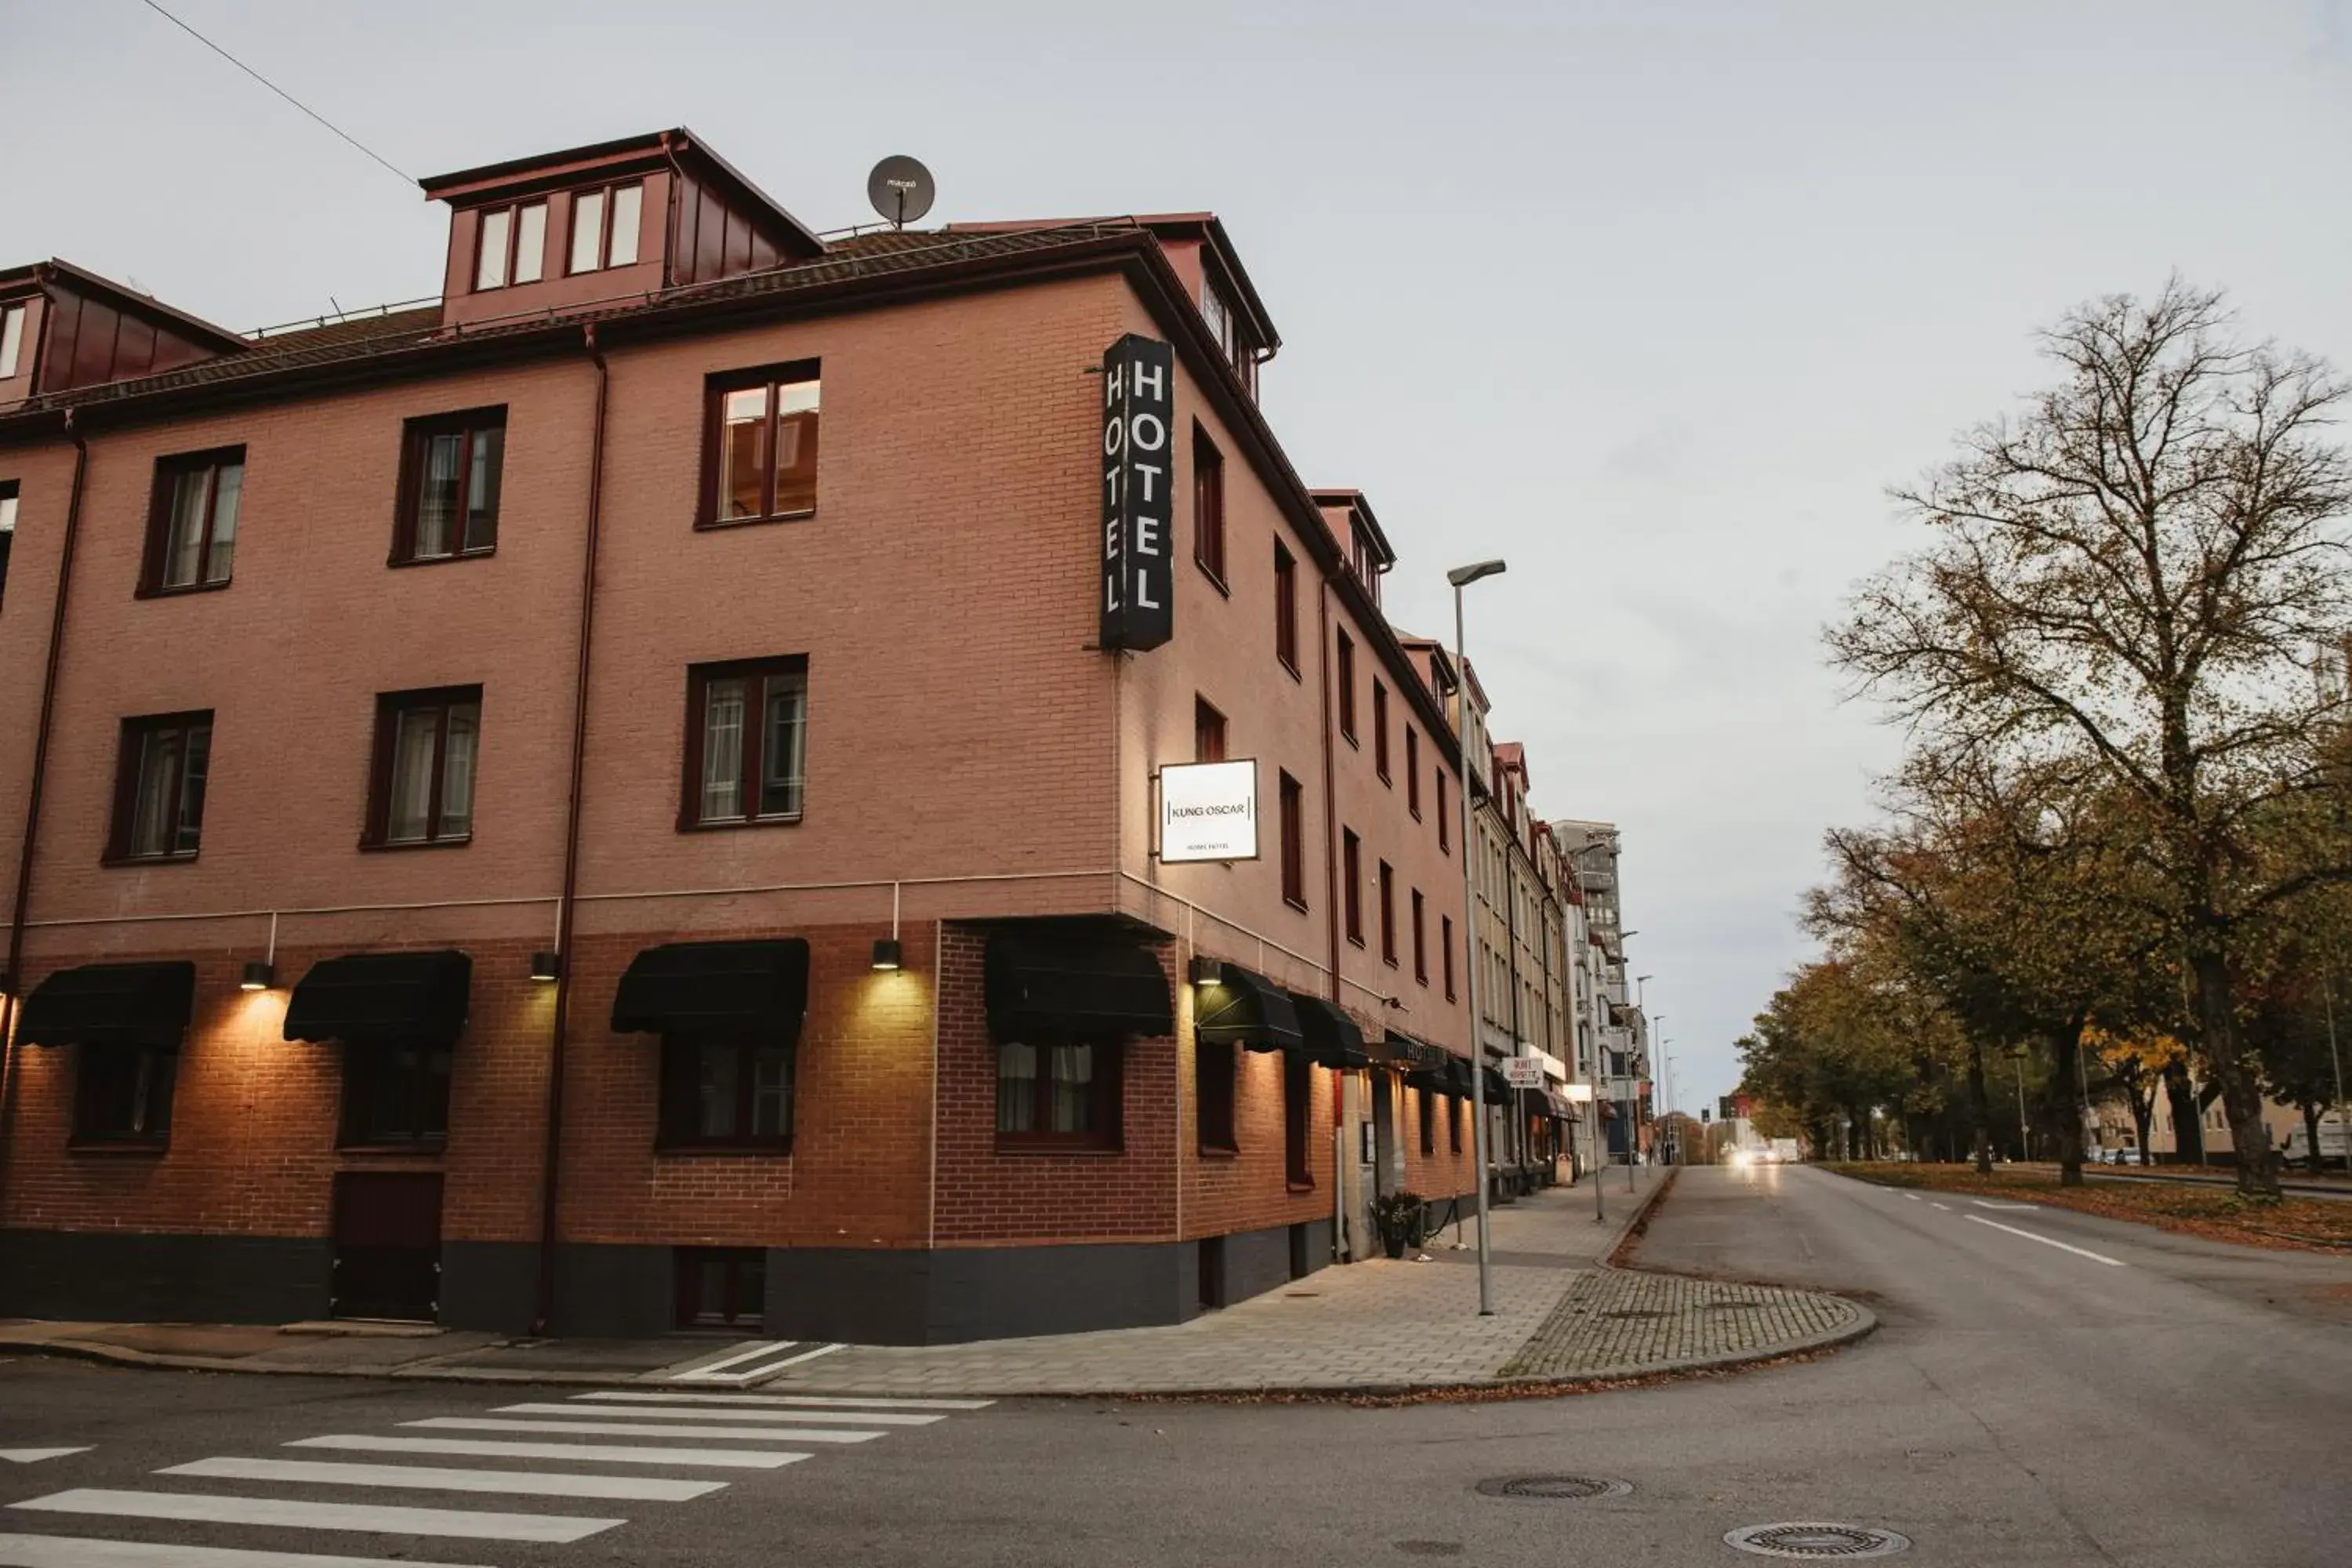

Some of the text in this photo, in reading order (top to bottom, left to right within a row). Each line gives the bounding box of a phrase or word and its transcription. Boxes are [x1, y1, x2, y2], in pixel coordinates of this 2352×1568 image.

[1105, 362, 1123, 614] HOTEL
[1131, 360, 1165, 610] HOTEL
[1172, 804, 1245, 818] KUNG OSCAR
